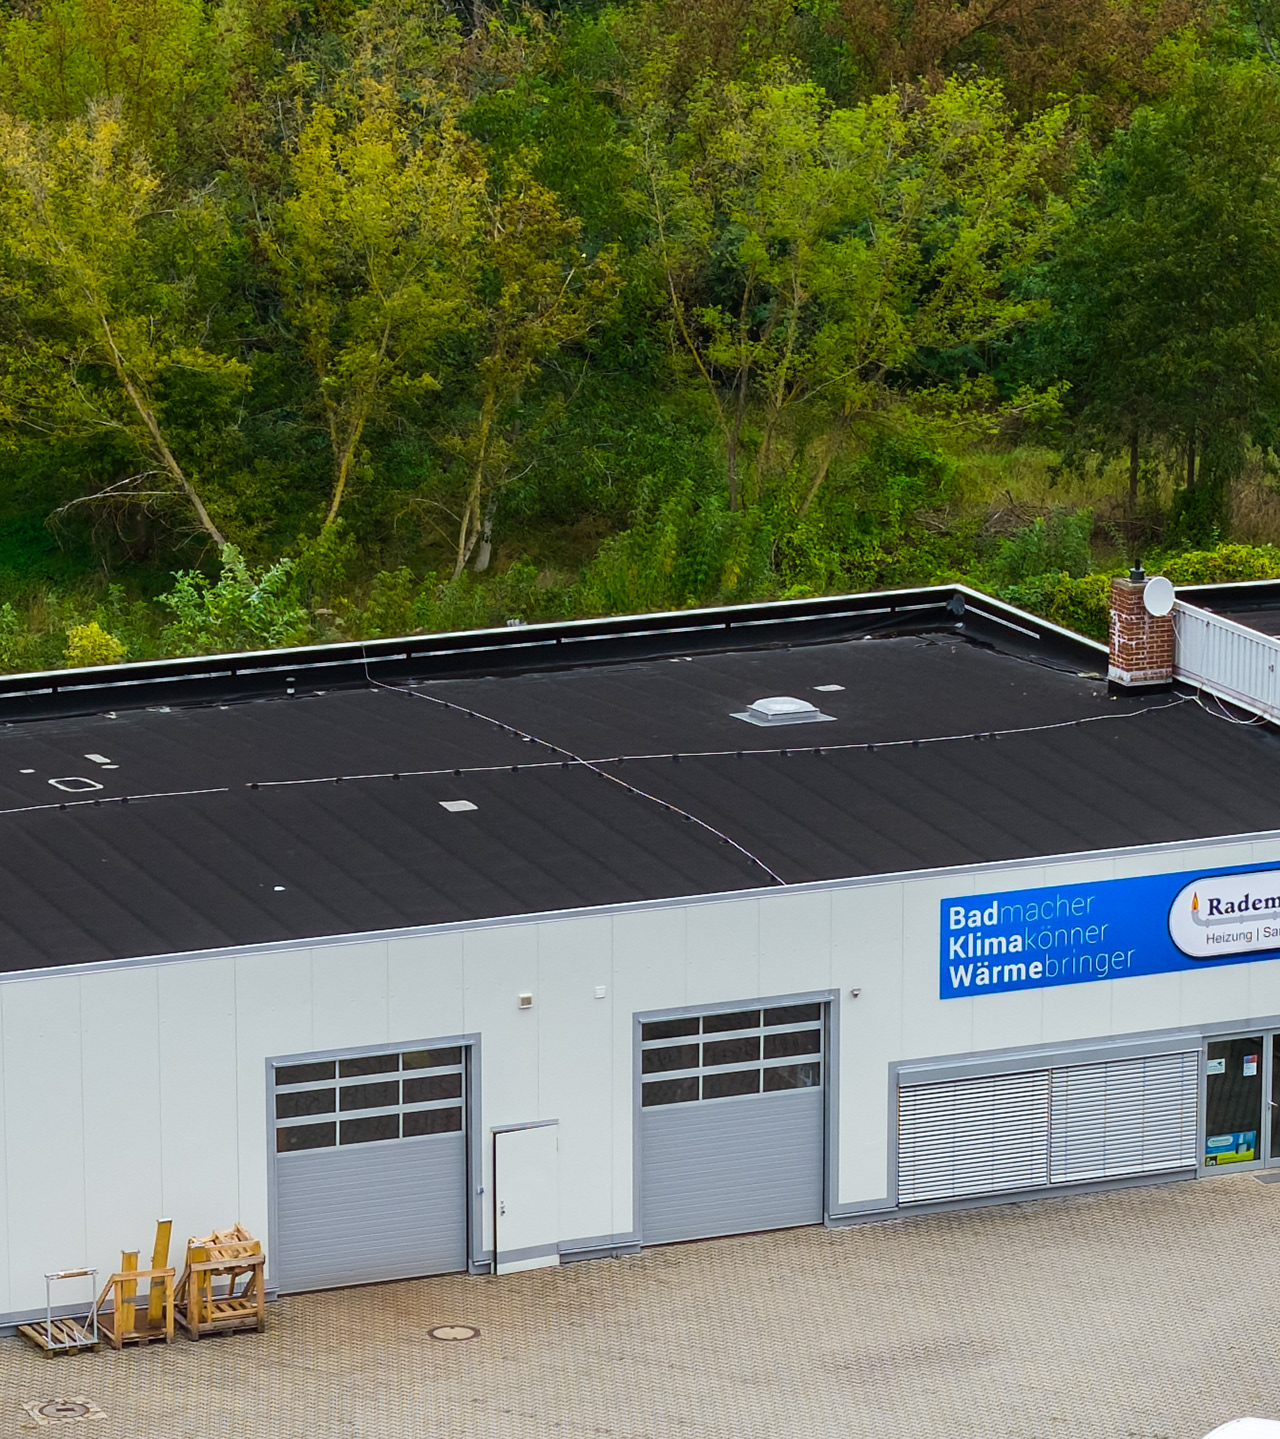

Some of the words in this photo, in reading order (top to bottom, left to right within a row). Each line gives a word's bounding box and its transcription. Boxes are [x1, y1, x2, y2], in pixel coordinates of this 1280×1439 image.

[949, 893, 1096, 930] Badmacher
[949, 923, 1109, 960] Klimakönner
[1206, 930, 1253, 945] Heizung
[949, 949, 1136, 989] Wärmebringer
